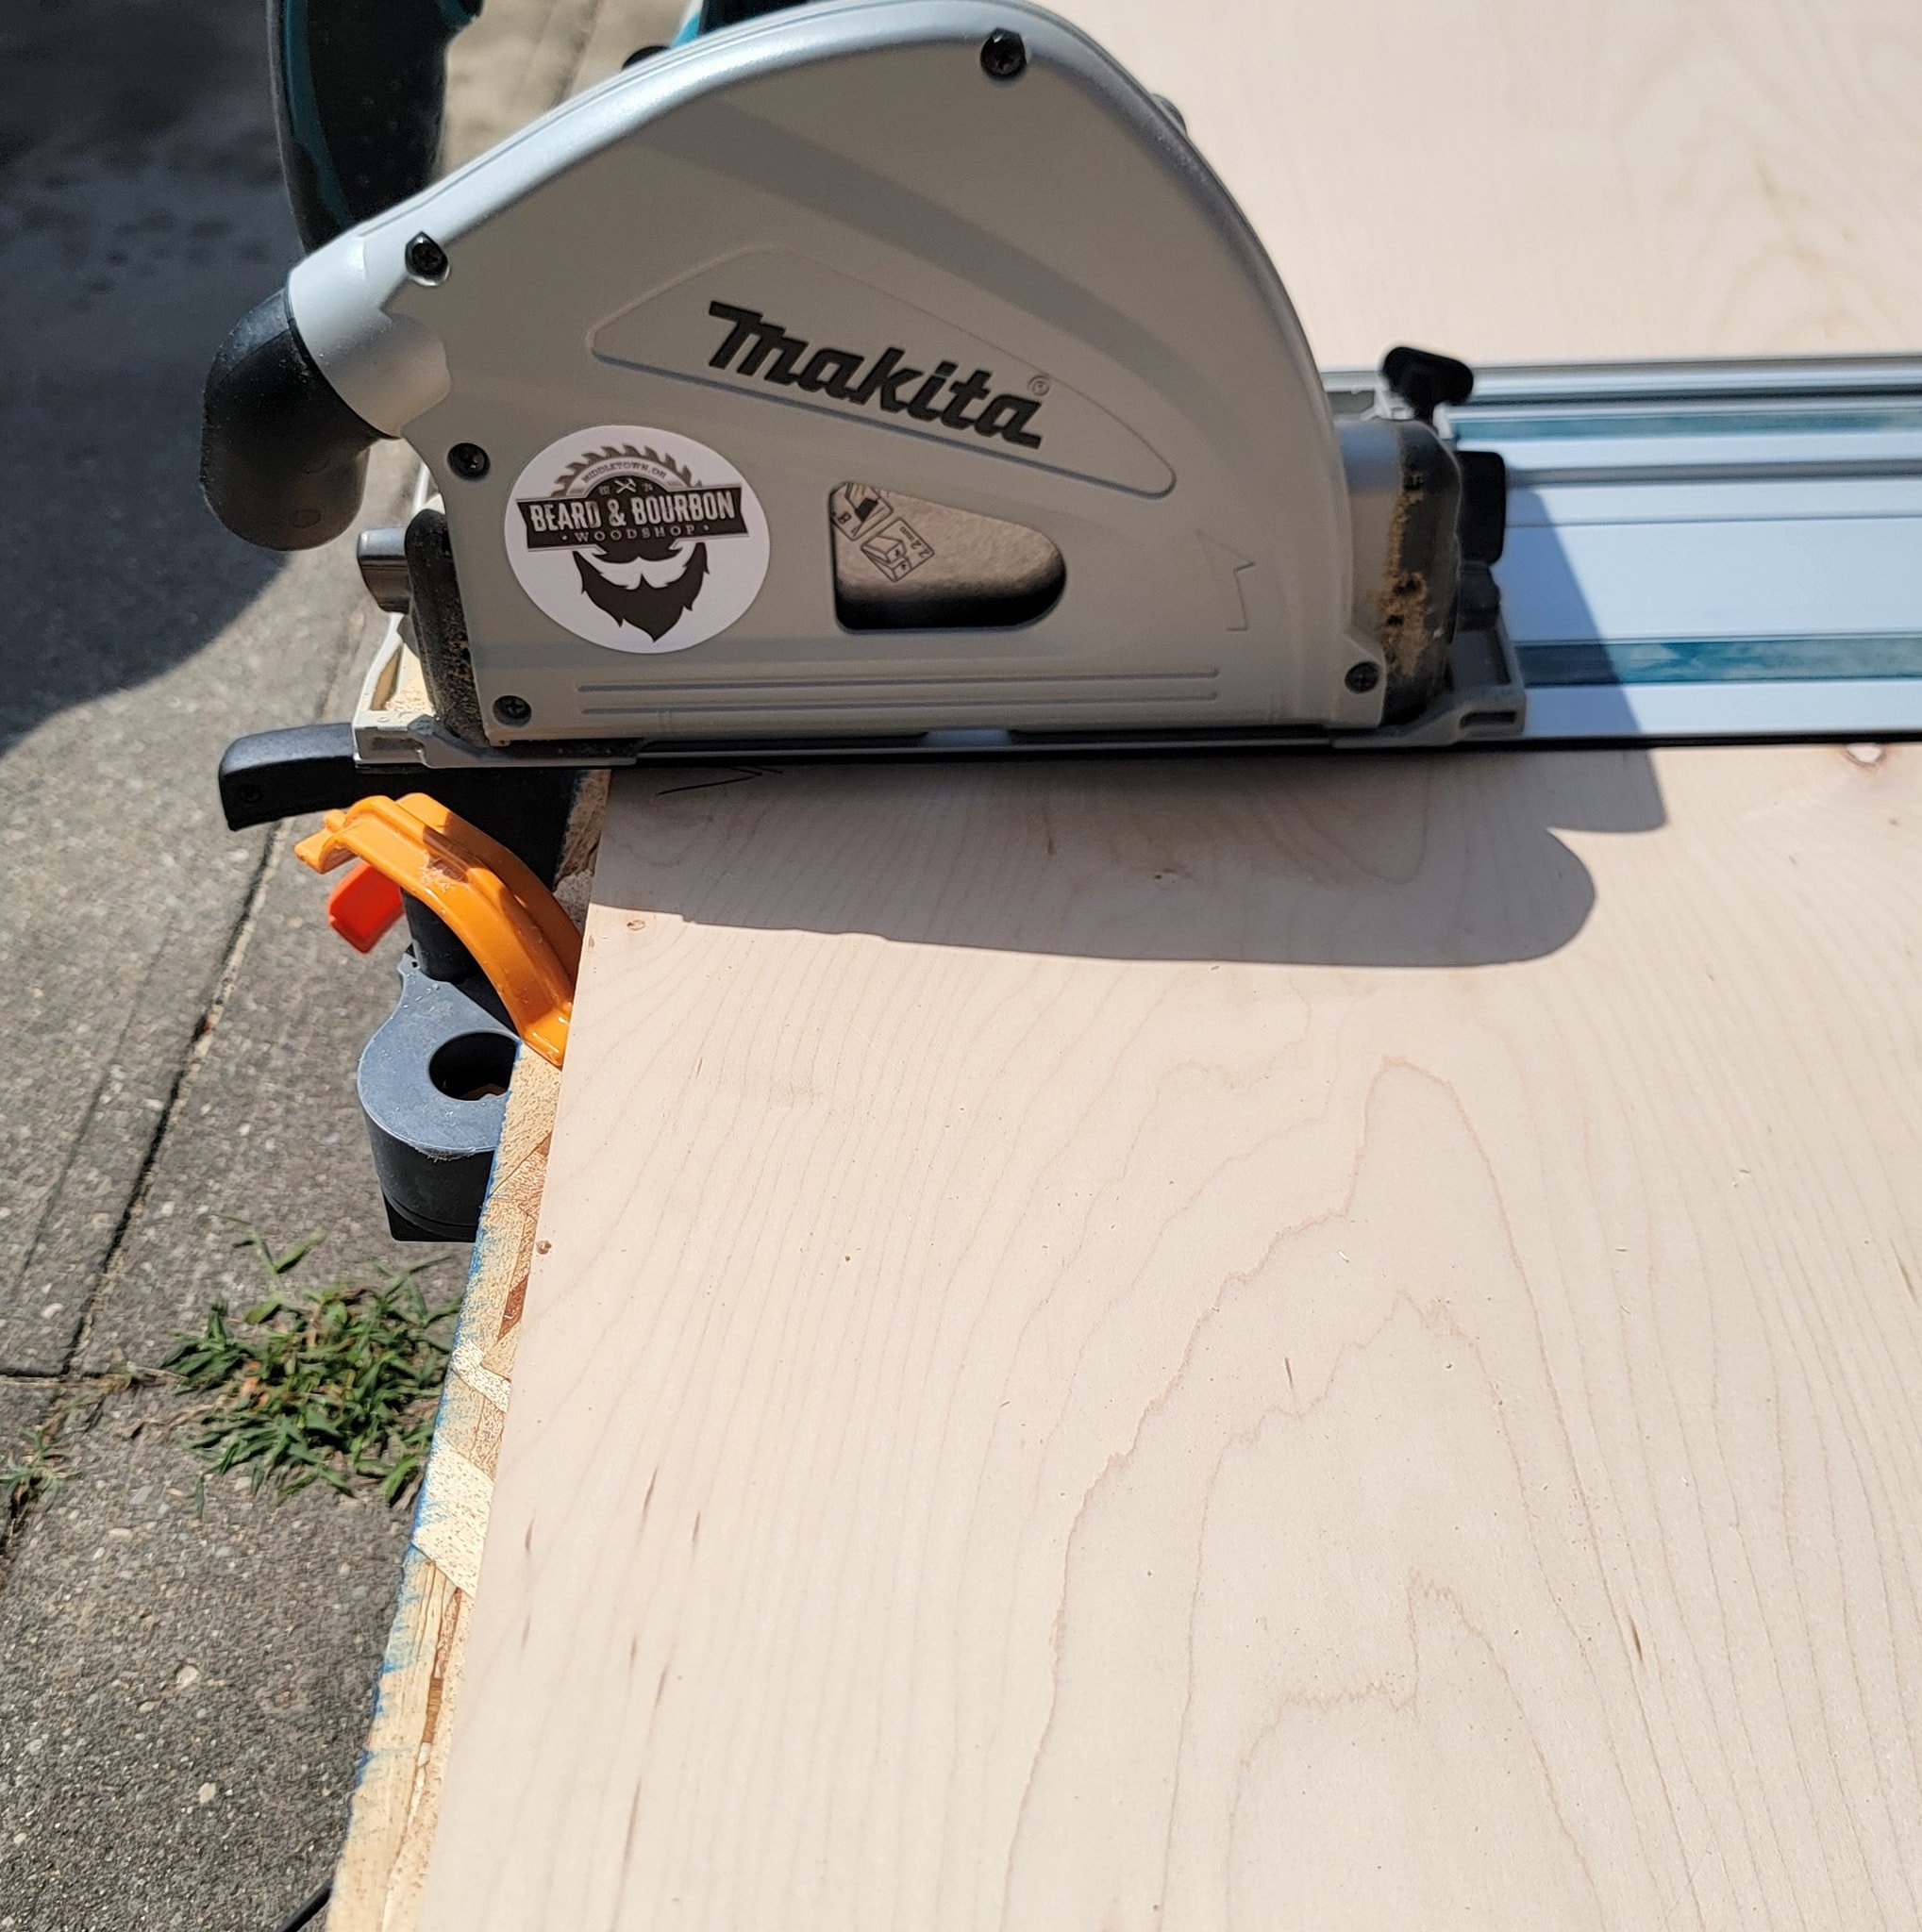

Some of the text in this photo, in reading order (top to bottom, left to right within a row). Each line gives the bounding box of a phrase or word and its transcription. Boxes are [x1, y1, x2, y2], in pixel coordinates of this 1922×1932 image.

[529, 491, 735, 532] BEARD & BOURBON
[574, 525, 695, 543] WOODSHOP
